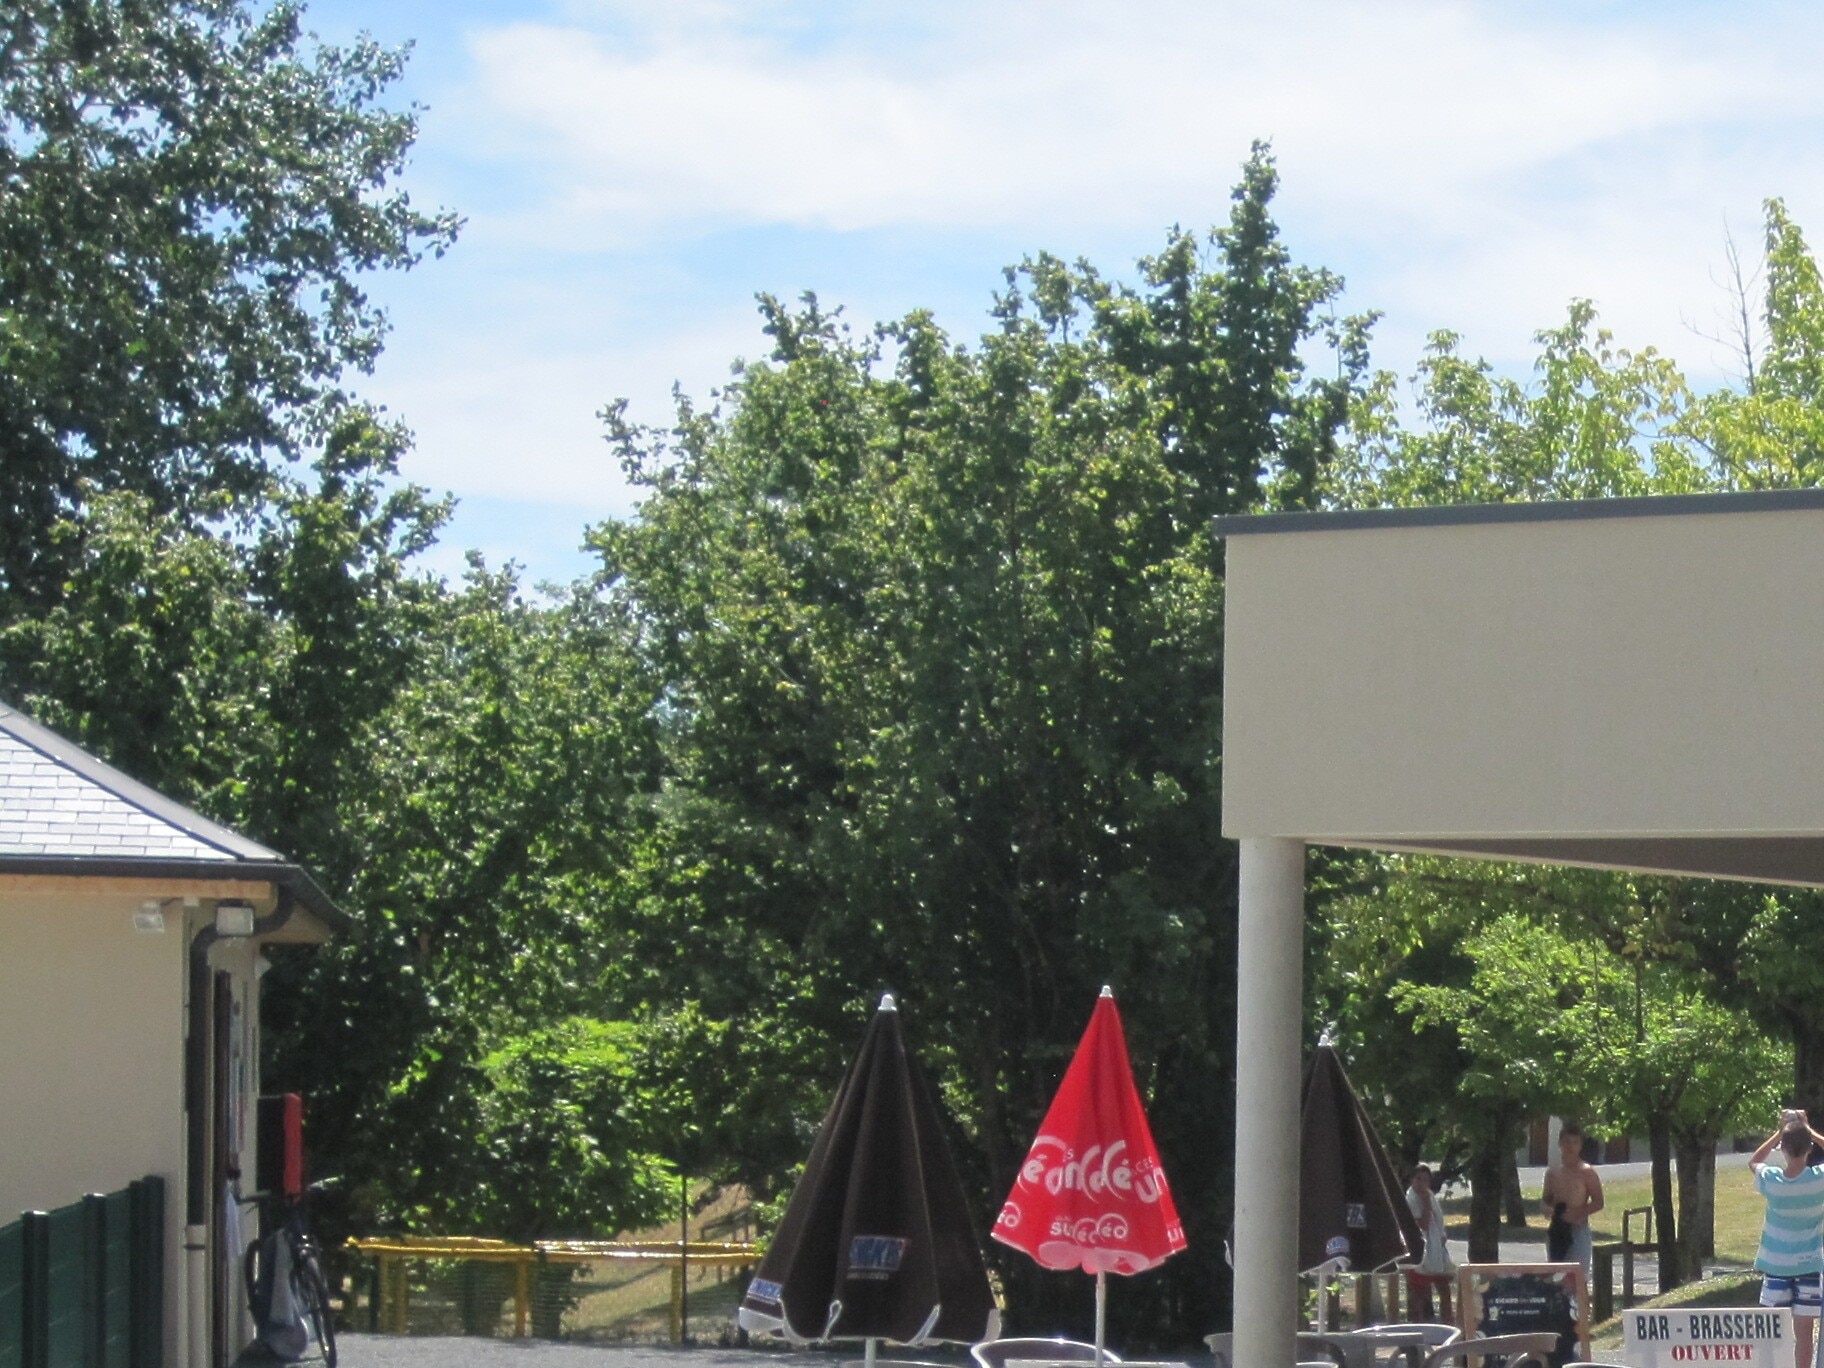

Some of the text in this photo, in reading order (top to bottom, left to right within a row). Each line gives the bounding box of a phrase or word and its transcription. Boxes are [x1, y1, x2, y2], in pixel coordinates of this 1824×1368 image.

[1636, 1315, 1670, 1341] BAR
[1690, 1313, 1782, 1340] BRASSERIE
[1671, 1343, 1754, 1361] OUVERT
